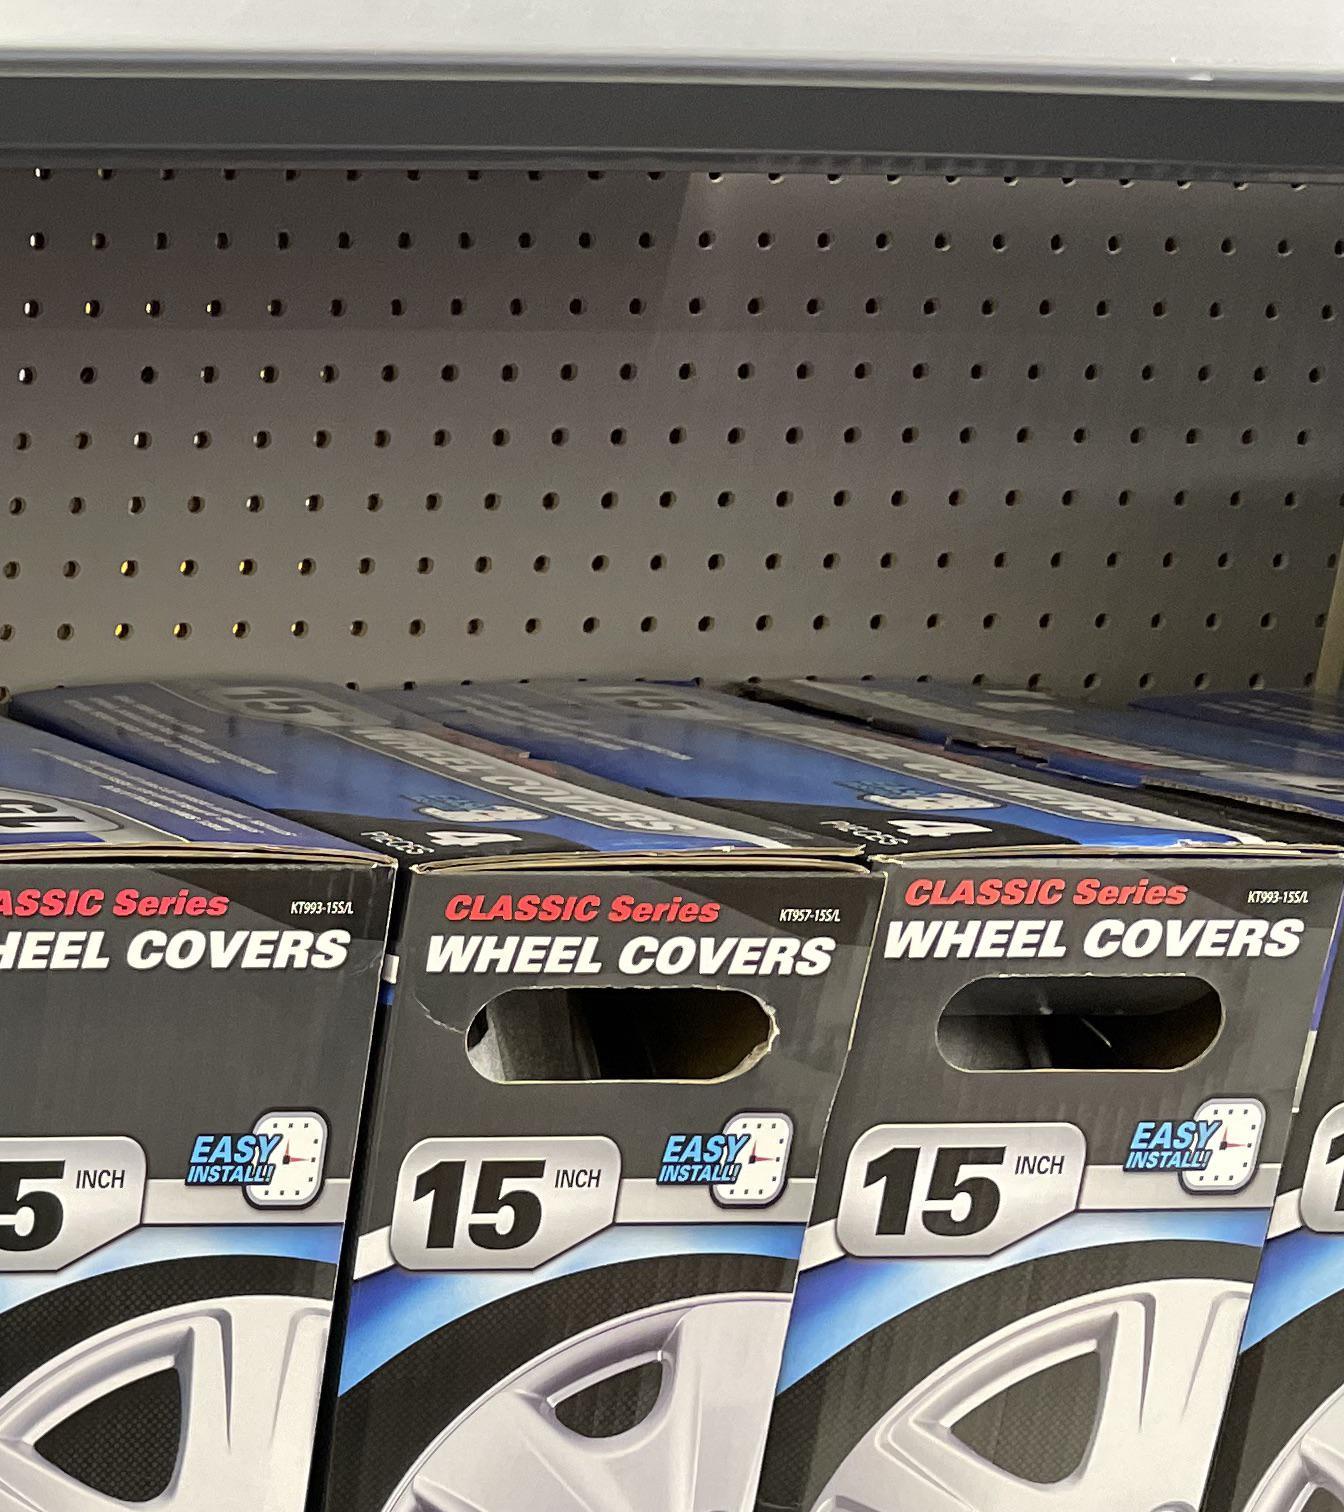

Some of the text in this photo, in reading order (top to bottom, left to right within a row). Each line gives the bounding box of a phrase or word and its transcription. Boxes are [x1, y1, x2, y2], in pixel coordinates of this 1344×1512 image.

[113, 890, 229, 917] Series
[291, 901, 353, 915] KT993-15S/L
[905, 880, 1188, 907] CLASSIC Series
[127, 930, 350, 969] COVERS
[426, 936, 835, 975] WHEEL COVERS
[413, 1160, 600, 1251] 15 INCH
